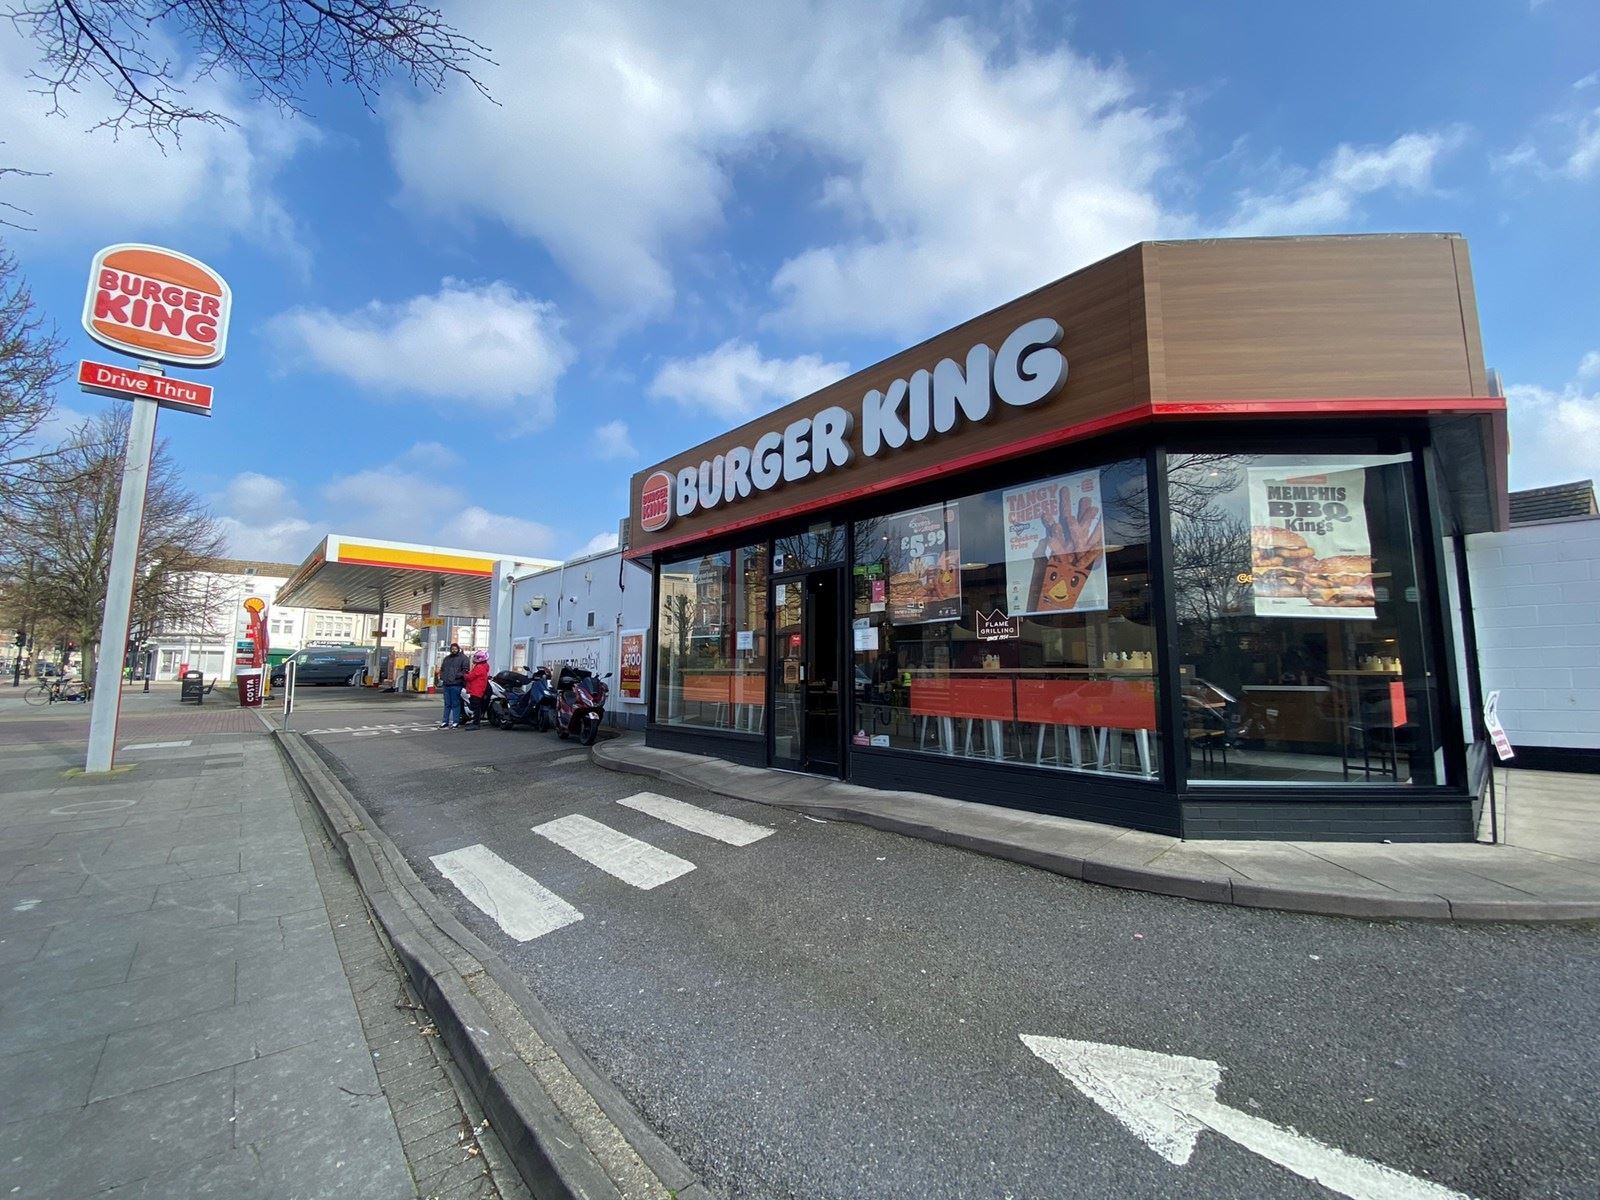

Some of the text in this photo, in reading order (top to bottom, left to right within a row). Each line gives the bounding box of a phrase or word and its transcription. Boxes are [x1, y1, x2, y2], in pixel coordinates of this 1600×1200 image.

[98, 268, 220, 318] BURGER
[93, 289, 218, 343] KING
[96, 368, 198, 401] Drive Thru
[676, 317, 1068, 517] BURGER KING
[643, 487, 669, 505] BURGER
[1007, 483, 1058, 513] TANGY
[1267, 486, 1346, 501] MEMPHIS
[643, 498, 669, 520] KING
[1008, 496, 1058, 524] CHEESE
[1267, 501, 1353, 523] BBQ
[1284, 517, 1334, 536] Kings
[901, 529, 946, 558] £5.99
[980, 627, 1015, 635] GRILLING
[985, 620, 1009, 628] FLAME
[246, 679, 256, 703] COSTA
